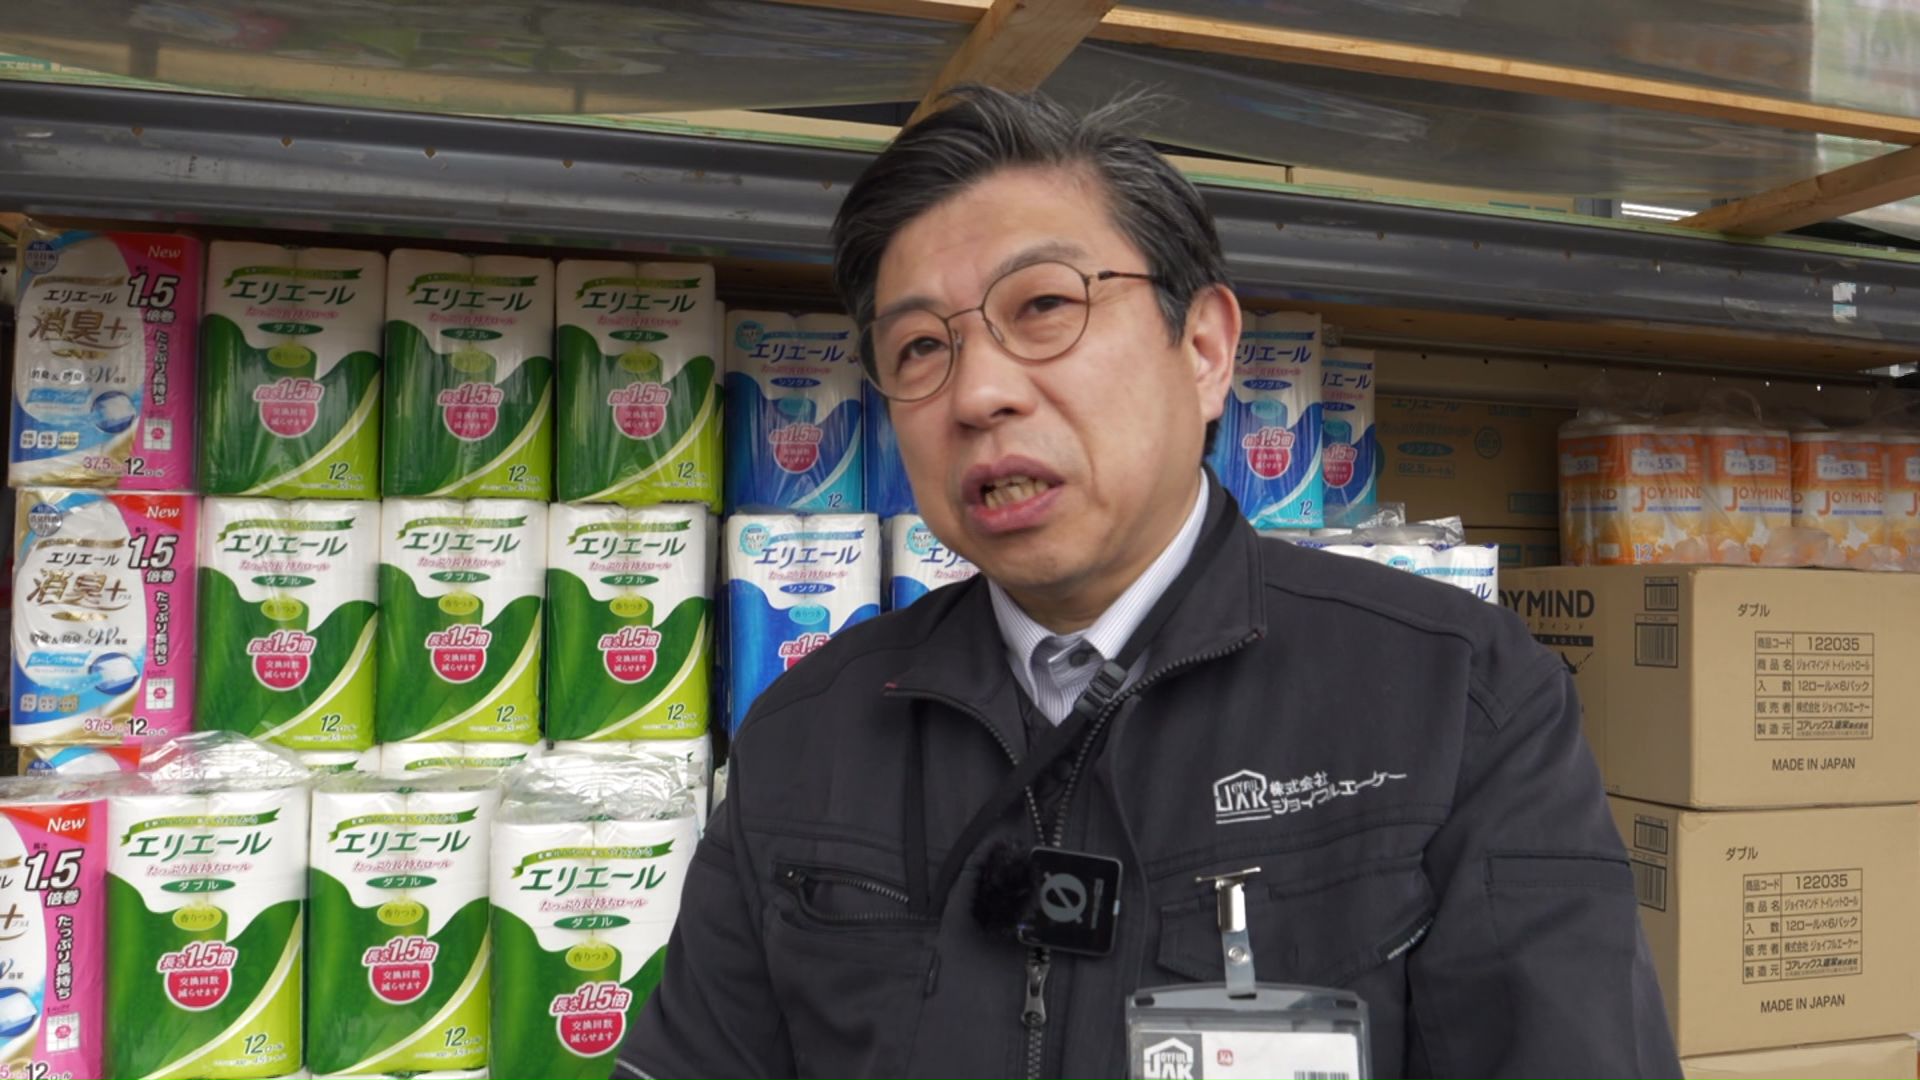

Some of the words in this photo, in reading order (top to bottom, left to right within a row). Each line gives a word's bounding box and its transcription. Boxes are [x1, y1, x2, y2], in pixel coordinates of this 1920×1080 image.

[147, 246, 181, 258] New
[43, 290, 118, 304] エリエール
[128, 273, 180, 308] 1.5
[229, 280, 356, 305] エリエール
[413, 287, 533, 312] エリエール
[582, 292, 696, 314] エリエール
[748, 343, 845, 364] エリエール
[1632, 486, 1702, 513] JOYMIND
[146, 506, 179, 519] New
[224, 534, 348, 559] エリエール
[402, 531, 521, 555] エリエール
[574, 536, 687, 560] エリエール
[46, 552, 120, 567] エリエール
[128, 534, 178, 569] 1.5
[754, 545, 862, 569] エリエール
[145, 570, 176, 584] 倍巻
[266, 576, 301, 586] ダブル
[443, 572, 478, 581] ダブル
[614, 576, 647, 584] ダブル
[787, 583, 828, 593] シングル
[1738, 603, 1770, 618] ダブル
[154, 591, 170, 665] たっぷり長持ち
[427, 625, 490, 648] 長さ1.5倍
[1757, 637, 1792, 649] 商品コード
[1807, 636, 1860, 651] 122035
[1772, 758, 1805, 771] MADE
[1807, 758, 1819, 771] IN
[1820, 757, 1856, 770] JAPAN
[1270, 772, 1329, 797] 株式会社
[1271, 769, 1407, 815] ジョイフルエーケー
[46, 817, 86, 833] New
[128, 831, 273, 862] エリエール
[335, 829, 471, 859] エリエール
[1725, 846, 1759, 862] ダブル
[25, 848, 85, 891] 1.5
[178, 880, 219, 892] ダブル
[383, 877, 421, 887] ダブル
[520, 864, 667, 897] エリエール
[1745, 878, 1780, 891] 商品コード
[1795, 874, 1848, 890] 122035
[538, 897, 648, 913] たっぷり長持ちロール
[180, 911, 217, 923] 香りつき
[571, 916, 614, 928] ダブル
[55, 914, 73, 1001] たっぷり長持ち
[160, 942, 237, 970] 長さ1.5倍
[365, 937, 438, 964] 長さ1.5倍
[573, 950, 610, 963] 香りつき
[179, 975, 220, 986] 交換回数
[381, 981, 422, 992] 減らせます
[177, 987, 220, 998] 減らせます
[552, 984, 629, 1013] 長さ1.5倍
[1760, 999, 1793, 1014] MADE
[1795, 998, 1808, 1011] IN
[1809, 994, 1845, 1009] JAPAN
[571, 1019, 613, 1031] 交換回数
[570, 1031, 614, 1044] 減らせます
